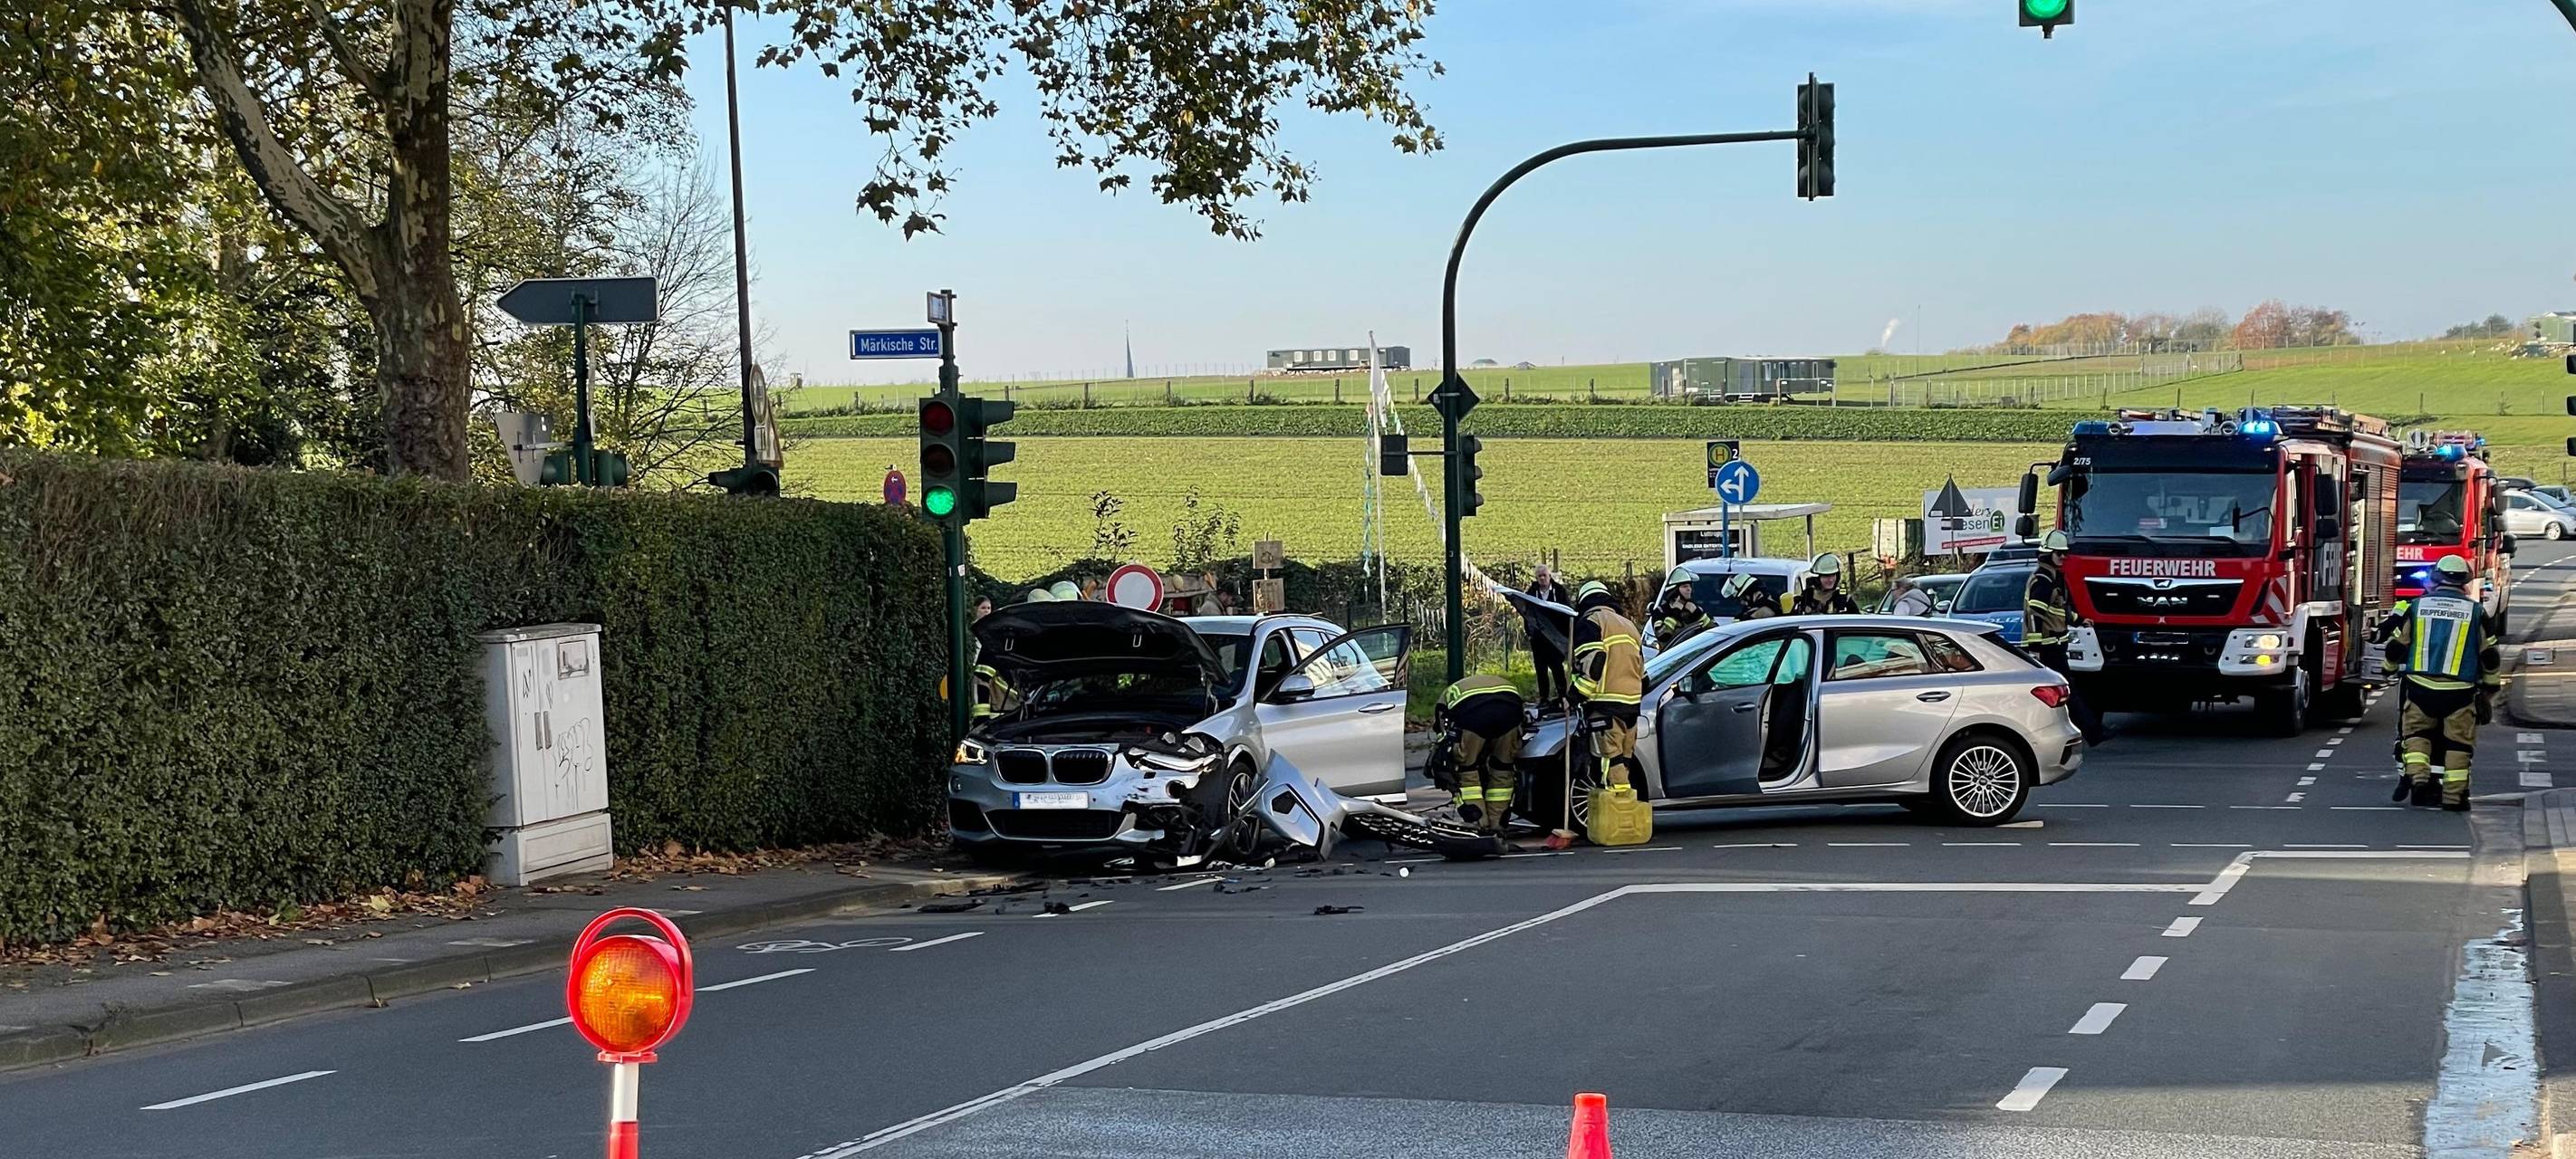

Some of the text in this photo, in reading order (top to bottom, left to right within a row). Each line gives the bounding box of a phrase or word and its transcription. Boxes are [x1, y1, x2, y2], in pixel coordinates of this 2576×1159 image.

[860, 337, 937, 352] Märkische Str.
[1732, 448, 1738, 459] 2
[2072, 457, 2091, 465] 2/75
[2396, 546, 2425, 560] EHR
[2110, 559, 2216, 577] FEUERWEHR
[2137, 596, 2188, 608] MAN
